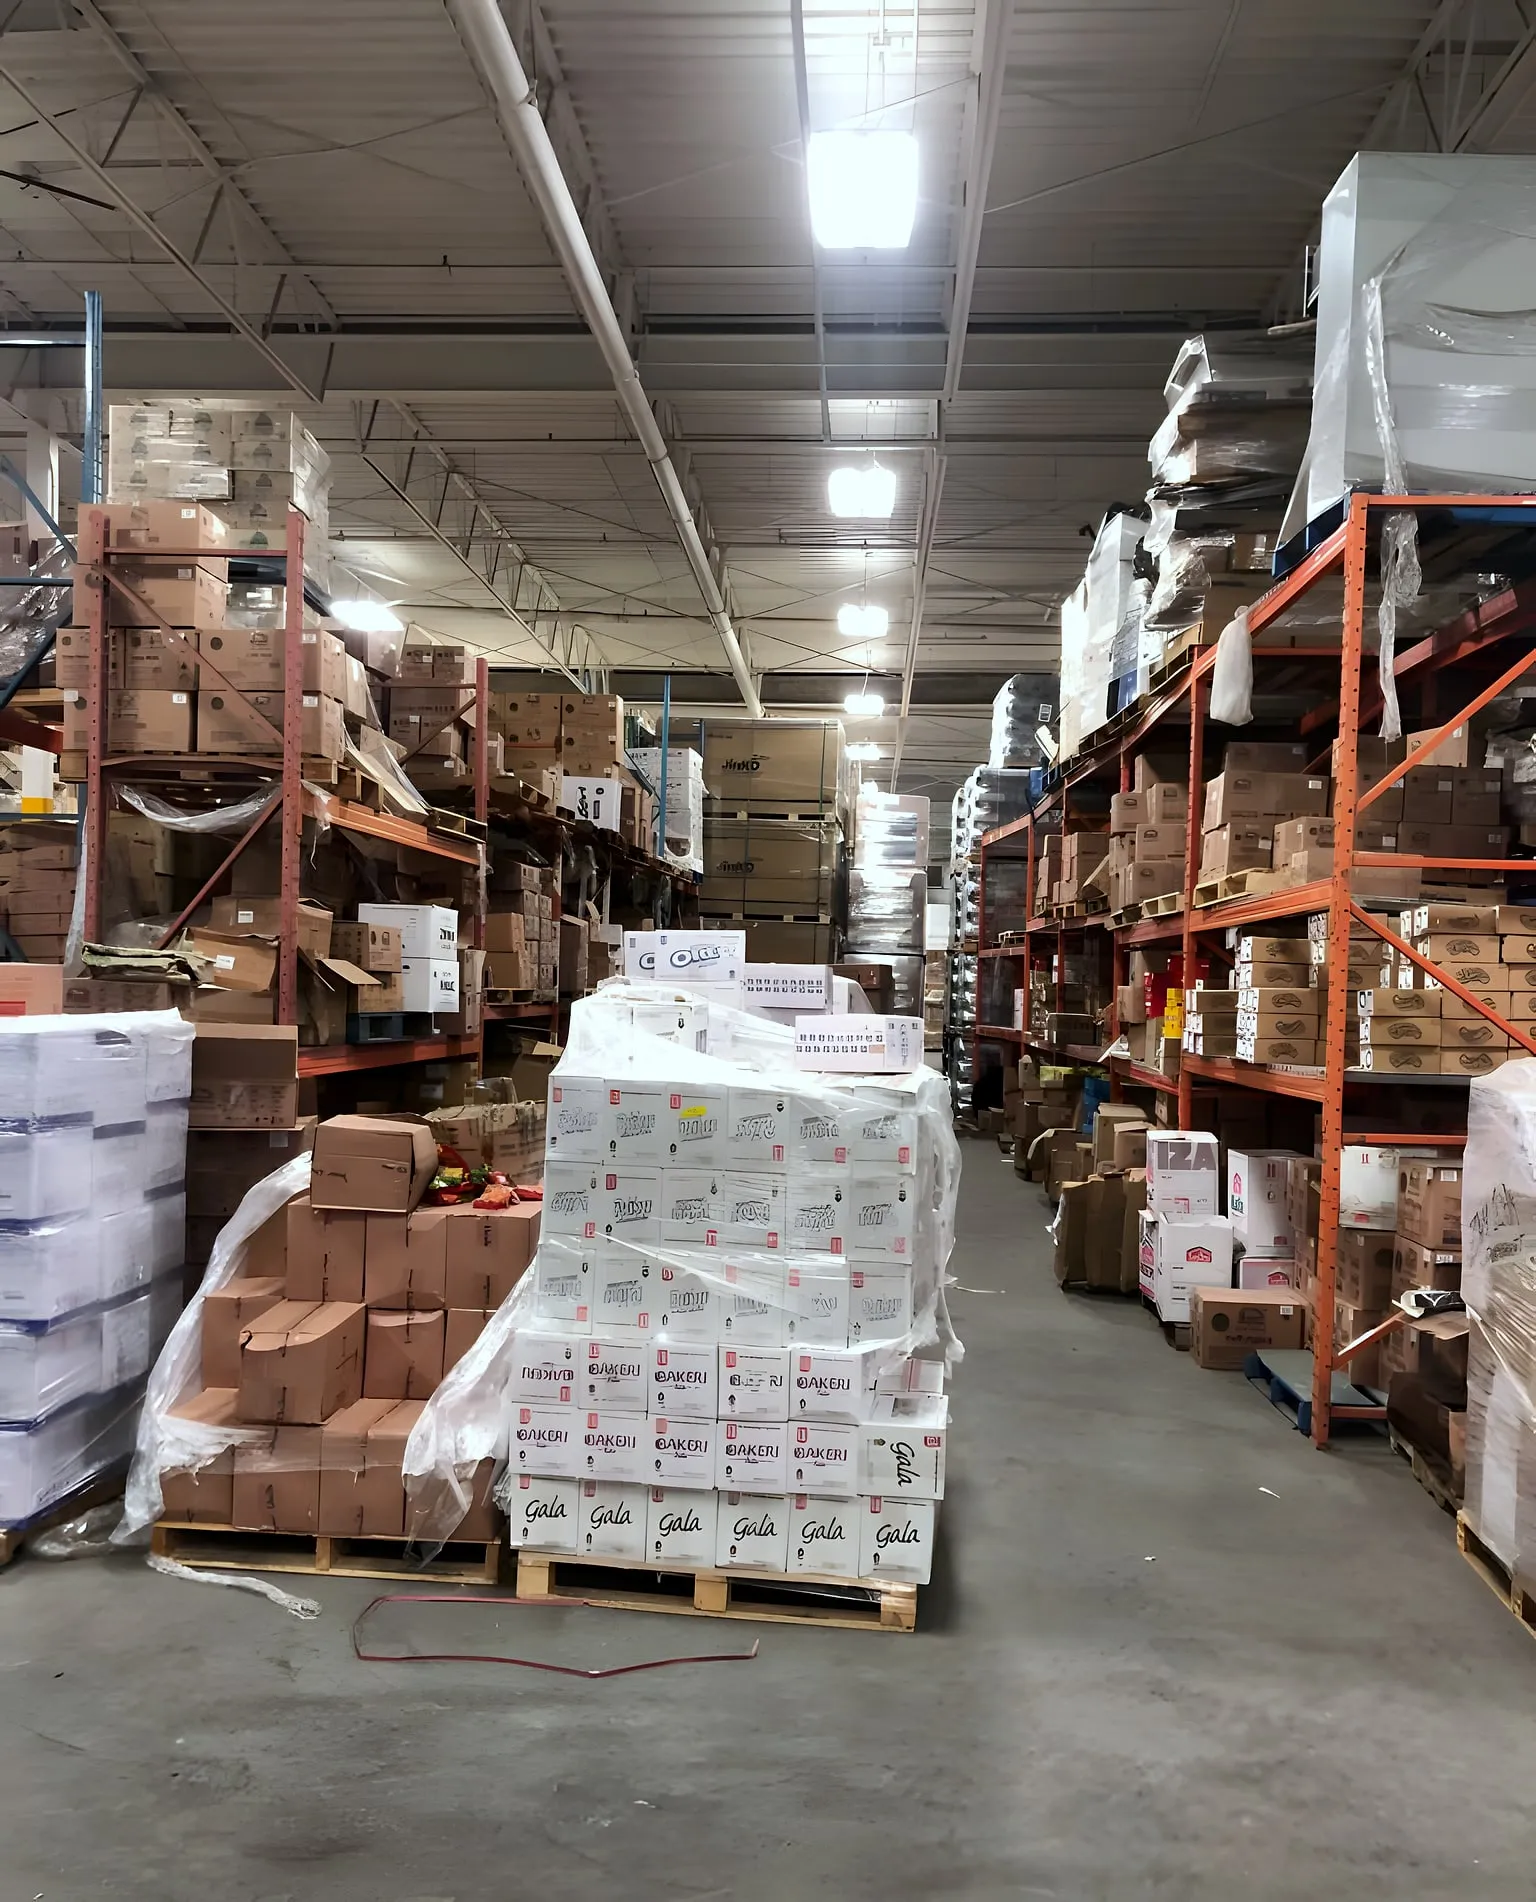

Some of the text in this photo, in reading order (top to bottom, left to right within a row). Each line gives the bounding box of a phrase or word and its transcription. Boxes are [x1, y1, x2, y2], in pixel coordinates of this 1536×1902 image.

[890, 1441, 921, 1488] Gala
[525, 1495, 567, 1523] Gala
[590, 1501, 633, 1530] Gala
[659, 1508, 702, 1537] Gala
[733, 1513, 778, 1542] Gala
[801, 1516, 846, 1544] Gala
[876, 1520, 921, 1548] Gala
